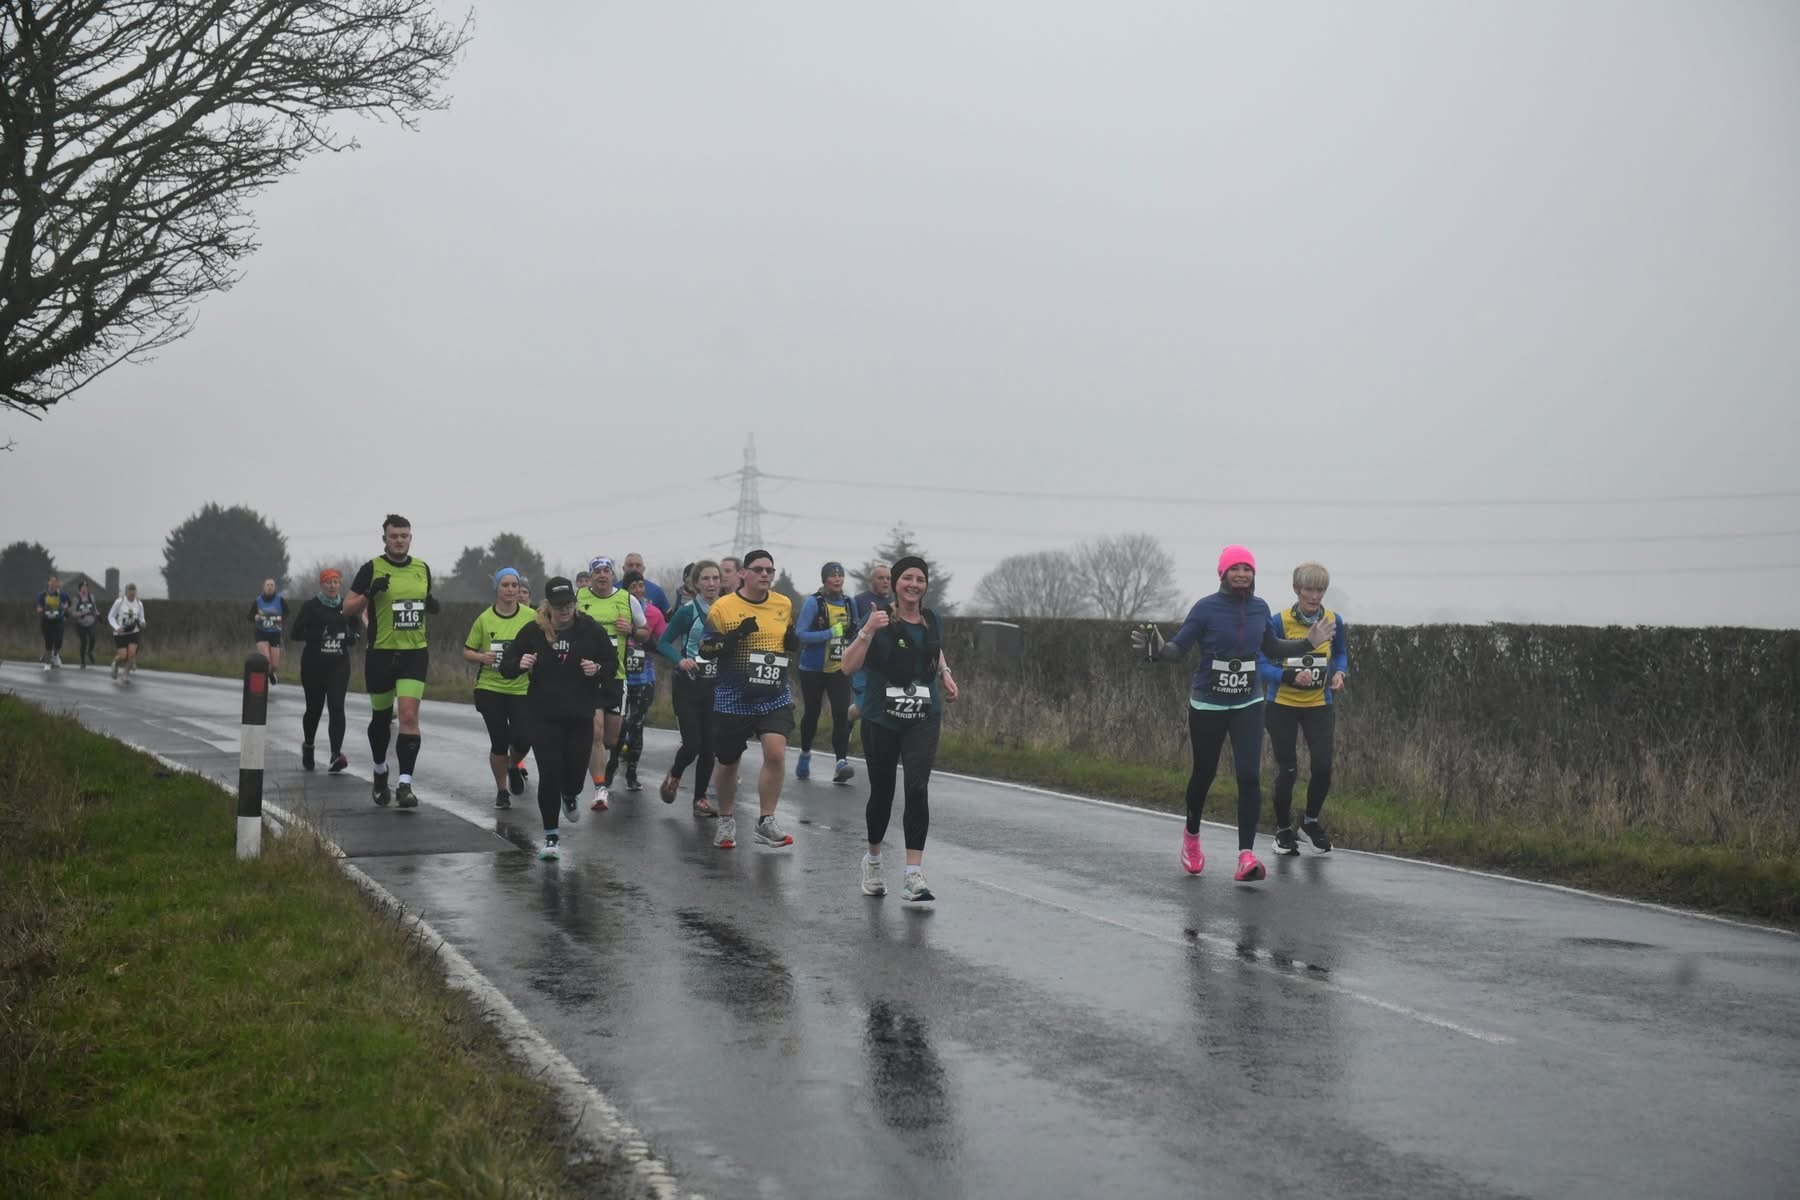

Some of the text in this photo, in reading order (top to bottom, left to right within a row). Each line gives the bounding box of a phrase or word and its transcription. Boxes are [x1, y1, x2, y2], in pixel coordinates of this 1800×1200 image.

[399, 611, 420, 622] 116
[626, 656, 640, 667] 03
[705, 663, 718, 675] 99
[755, 665, 781, 680] 138
[1218, 673, 1249, 687] 504
[895, 698, 923, 712] 721
